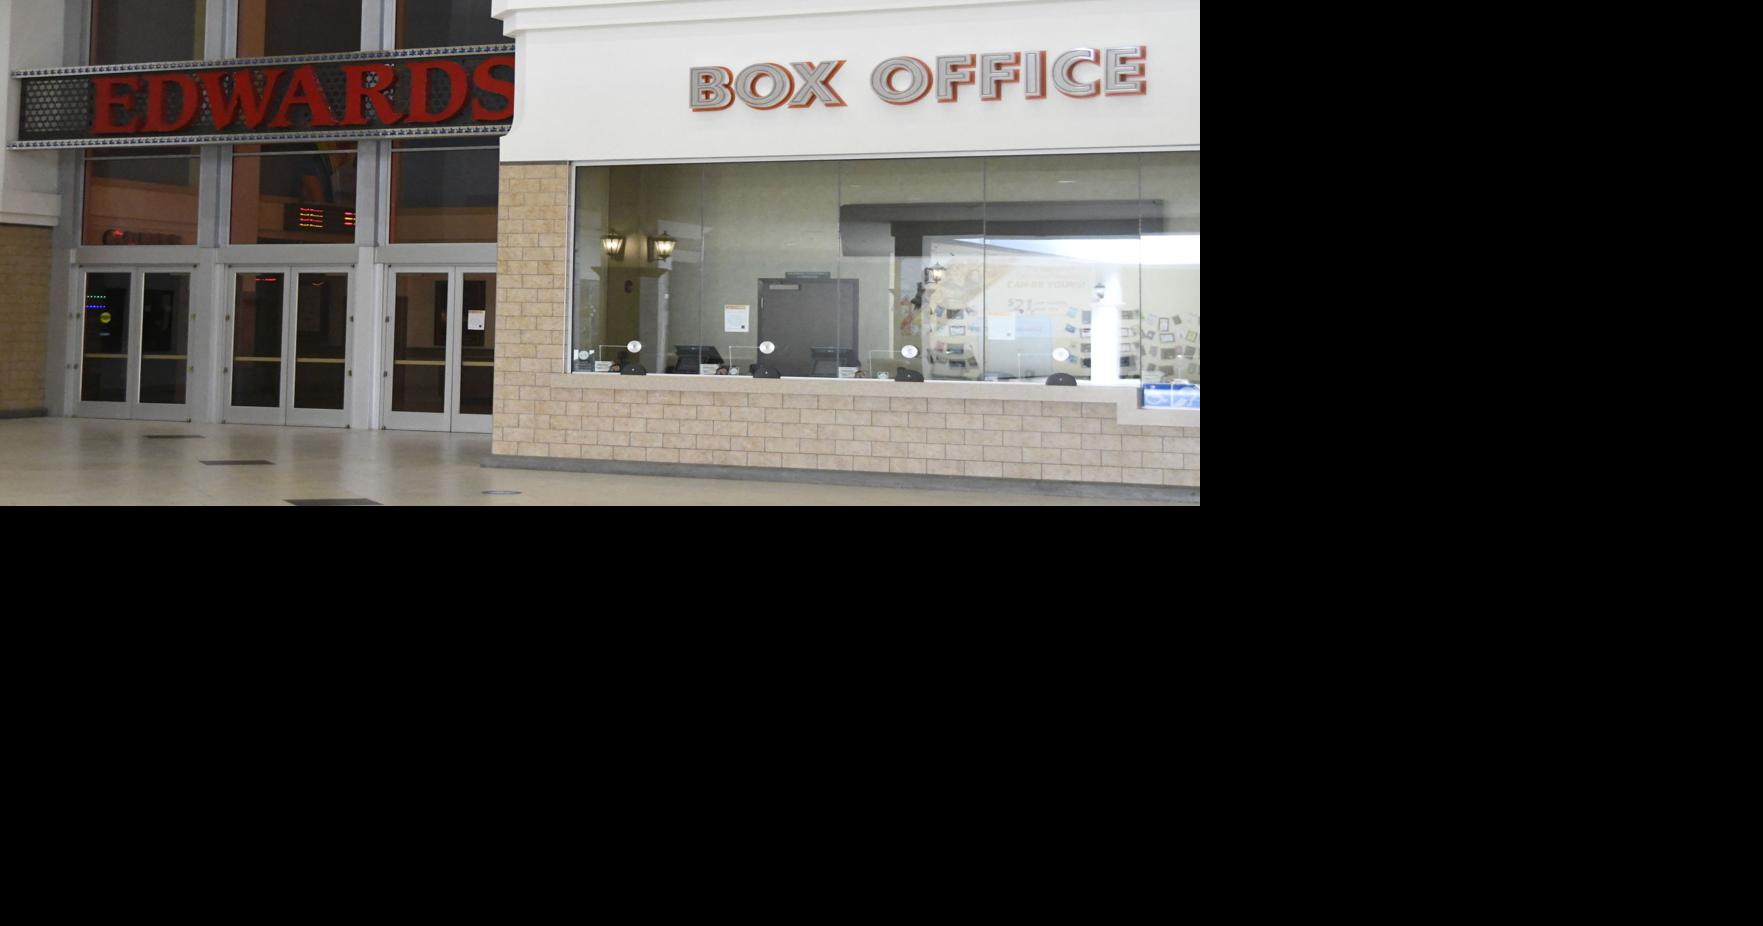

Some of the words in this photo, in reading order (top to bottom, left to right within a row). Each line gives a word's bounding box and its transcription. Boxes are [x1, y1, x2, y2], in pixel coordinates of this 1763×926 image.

[91, 54, 514, 135] EDWARDS
[689, 60, 847, 112] BOX
[870, 46, 1147, 105] OFFICE
